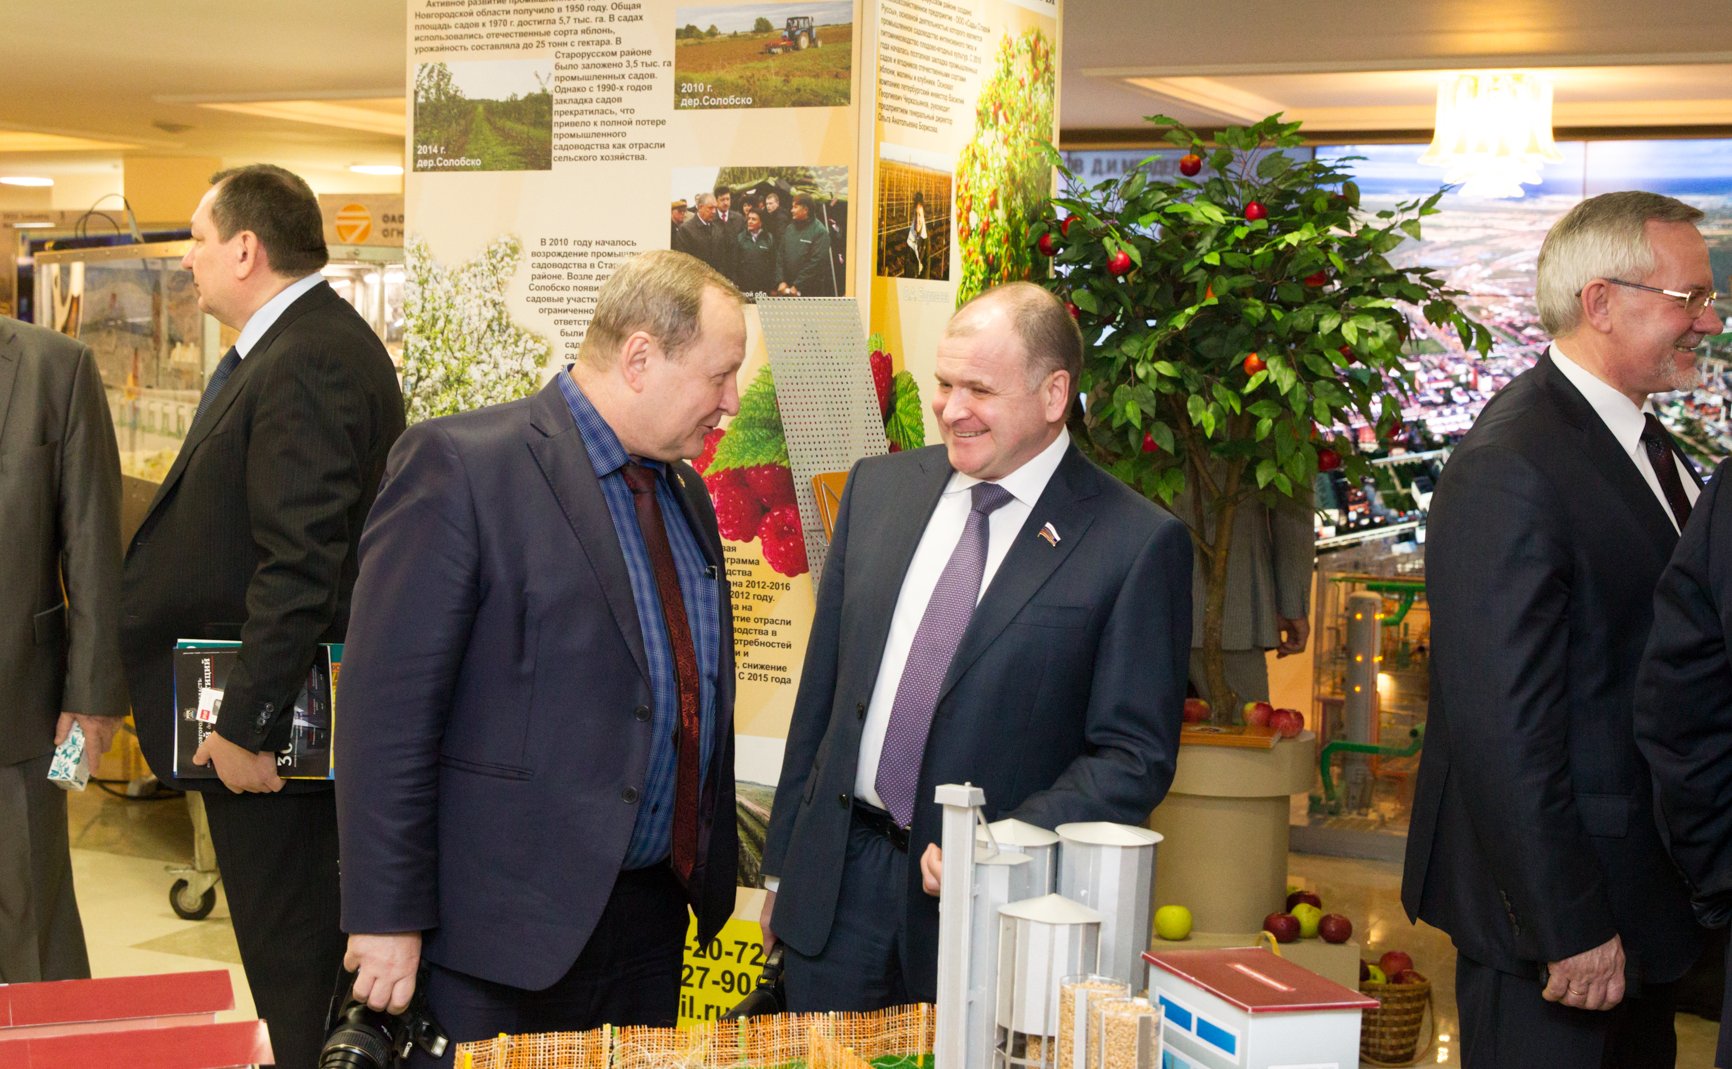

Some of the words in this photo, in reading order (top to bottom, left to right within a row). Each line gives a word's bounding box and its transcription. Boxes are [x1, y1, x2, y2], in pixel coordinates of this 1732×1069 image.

[414, 9, 473, 19] Новгородской
[513, 7, 554, 16] получило
[565, 3, 584, 12] 1950
[610, 2, 641, 10] Общая
[489, 19, 507, 27] 1970
[516, 18, 556, 27] достигла
[558, 16, 570, 25] 5,7
[608, 14, 615, 22] В
[485, 30, 551, 39] отечественные
[553, 29, 578, 37] сорта
[414, 45, 468, 54] урожайность
[535, 40, 545, 48] 25
[615, 36, 621, 45] В
[554, 50, 617, 60] Старорусском
[619, 50, 652, 58] районе
[625, 59, 638, 68] 3,5
[554, 74, 625, 83] промышленных
[554, 85, 586, 94] Однако
[596, 83, 623, 92] 1990-х
[681, 83, 704, 92] 2010
[680, 95, 752, 107] дер.Солобско
[554, 119, 591, 129] привело
[600, 118, 632, 126] полной
[553, 131, 626, 140] промышленного
[417, 145, 438, 154] 2014
[628, 142, 665, 150] отрасли
[417, 157, 481, 168] дер.Солобско
[573, 240, 592, 248] году
[531, 273, 564, 281] районе.
[567, 272, 593, 280] Возле
[528, 283, 570, 291] Солобско
[746, 581, 790, 591] 2012-2016
[730, 591, 750, 600] 2012
[753, 595, 775, 603] году.
[754, 617, 792, 627] отрасли
[742, 662, 787, 672] снижение
[748, 672, 768, 682] 2015
[771, 675, 791, 684] года
